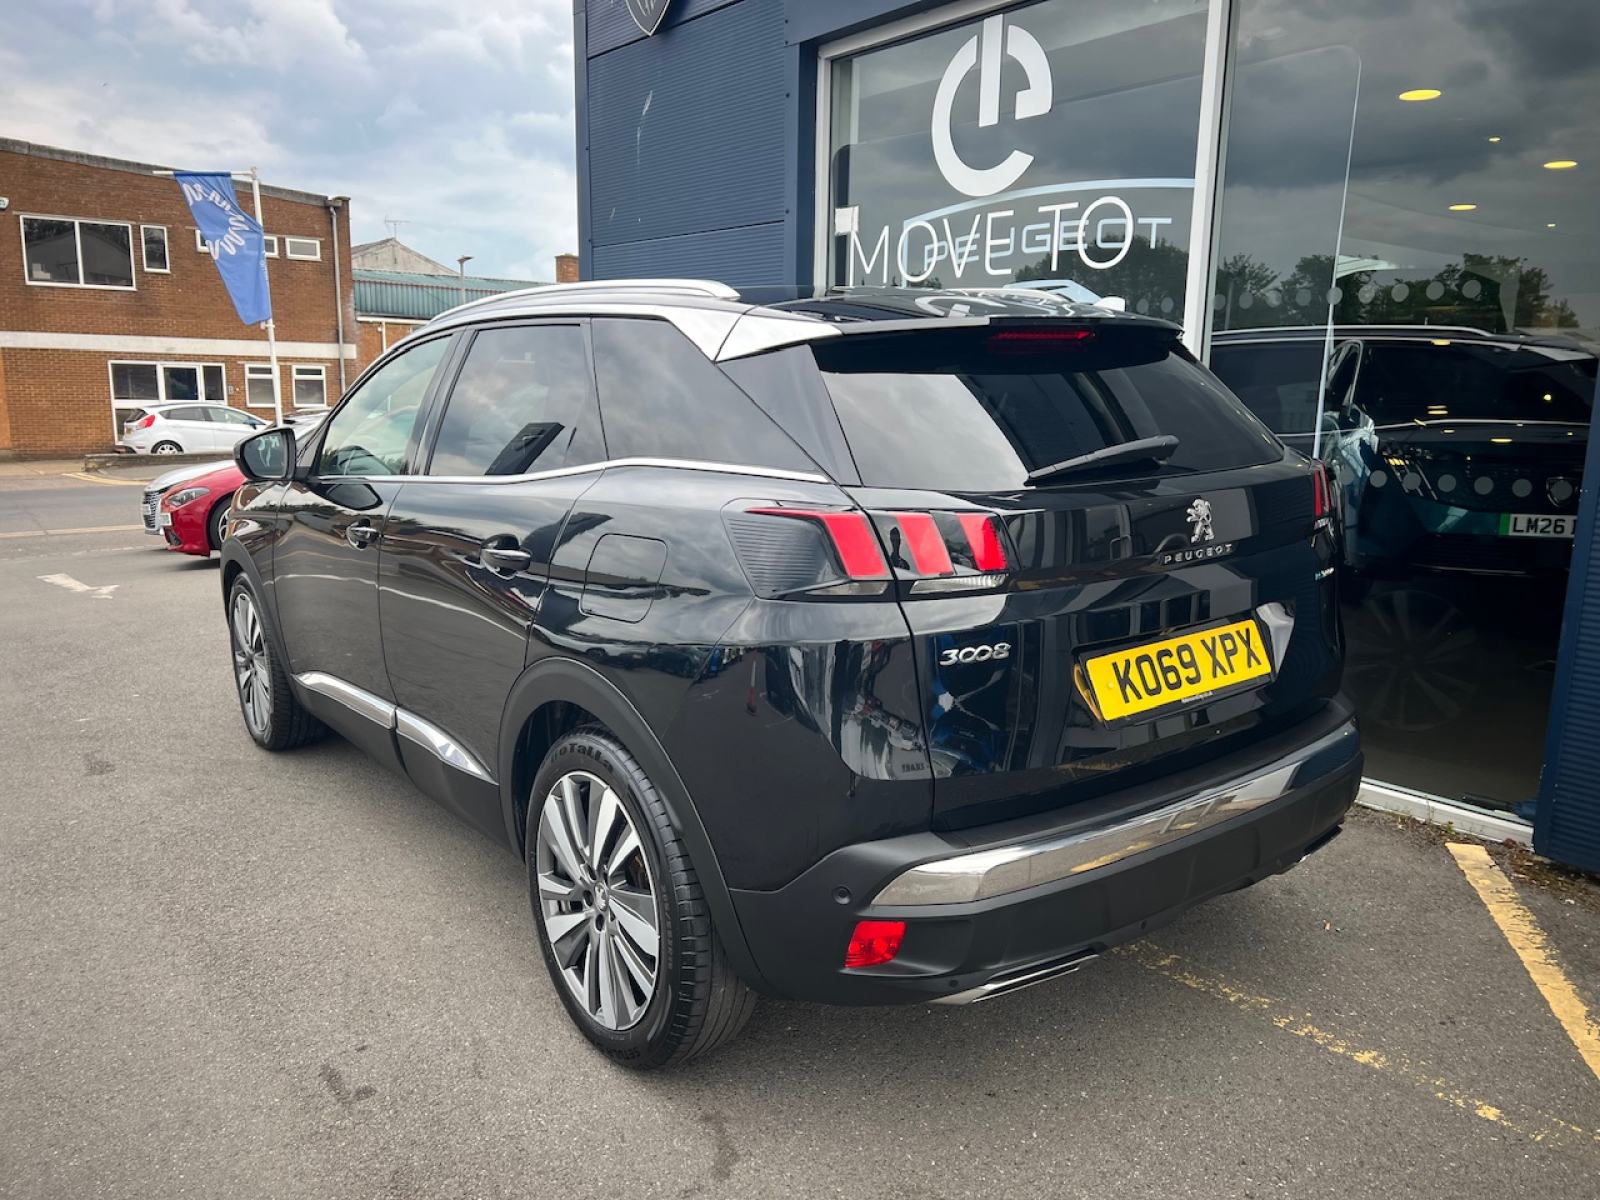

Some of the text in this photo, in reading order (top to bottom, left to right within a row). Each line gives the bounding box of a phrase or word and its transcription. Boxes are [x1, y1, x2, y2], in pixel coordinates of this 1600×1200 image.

[849, 196, 1134, 287] MOVE TO
[1512, 517, 1566, 534] LM26
[1163, 543, 1233, 565] PEUGEOT
[939, 642, 1012, 667] 3008
[1111, 627, 1263, 704] KO69 XPX
